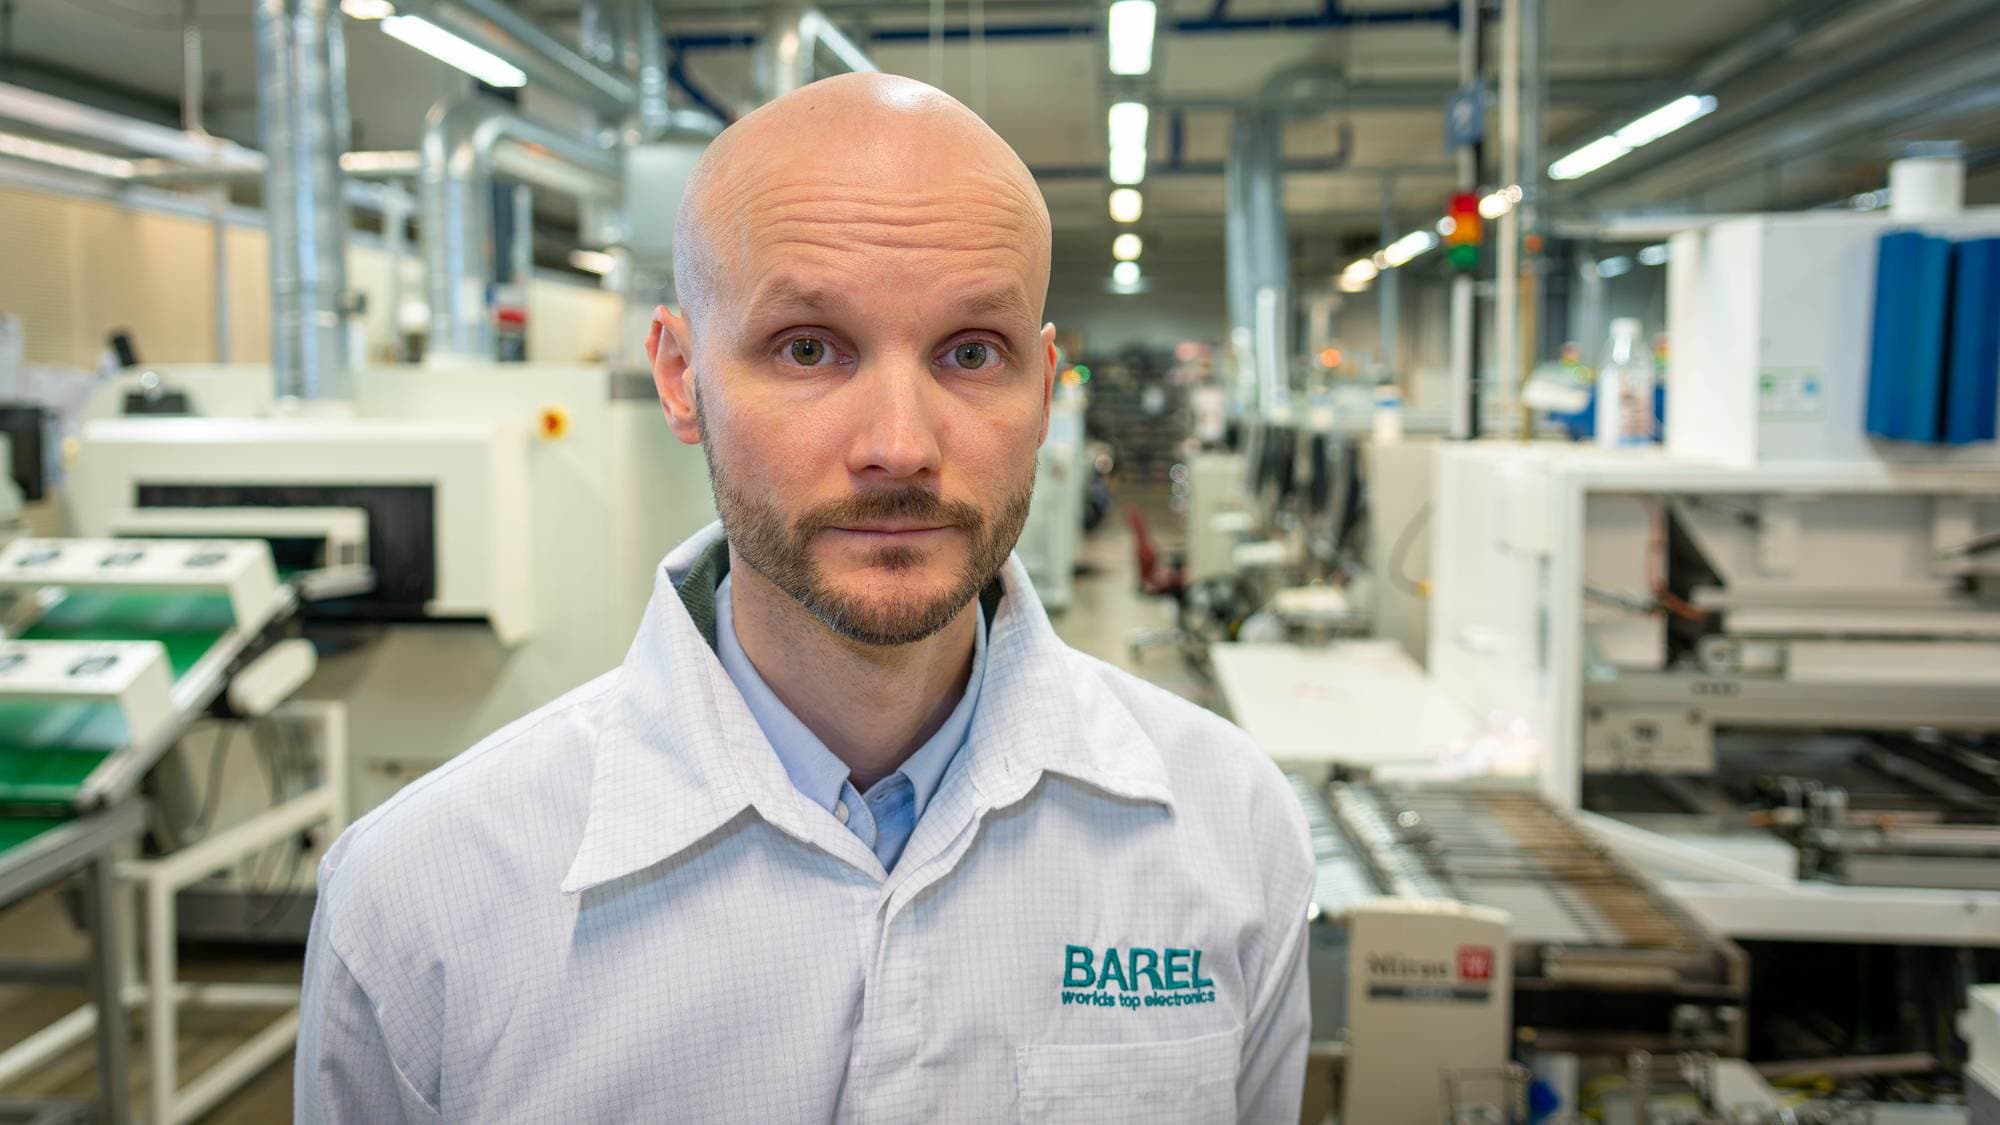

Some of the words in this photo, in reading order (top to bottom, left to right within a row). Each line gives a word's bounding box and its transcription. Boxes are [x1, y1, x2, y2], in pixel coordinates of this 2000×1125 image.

[1063, 944, 1215, 991] BAREL
[1119, 993, 1141, 1011] top
[1144, 990, 1215, 1007] electronics
